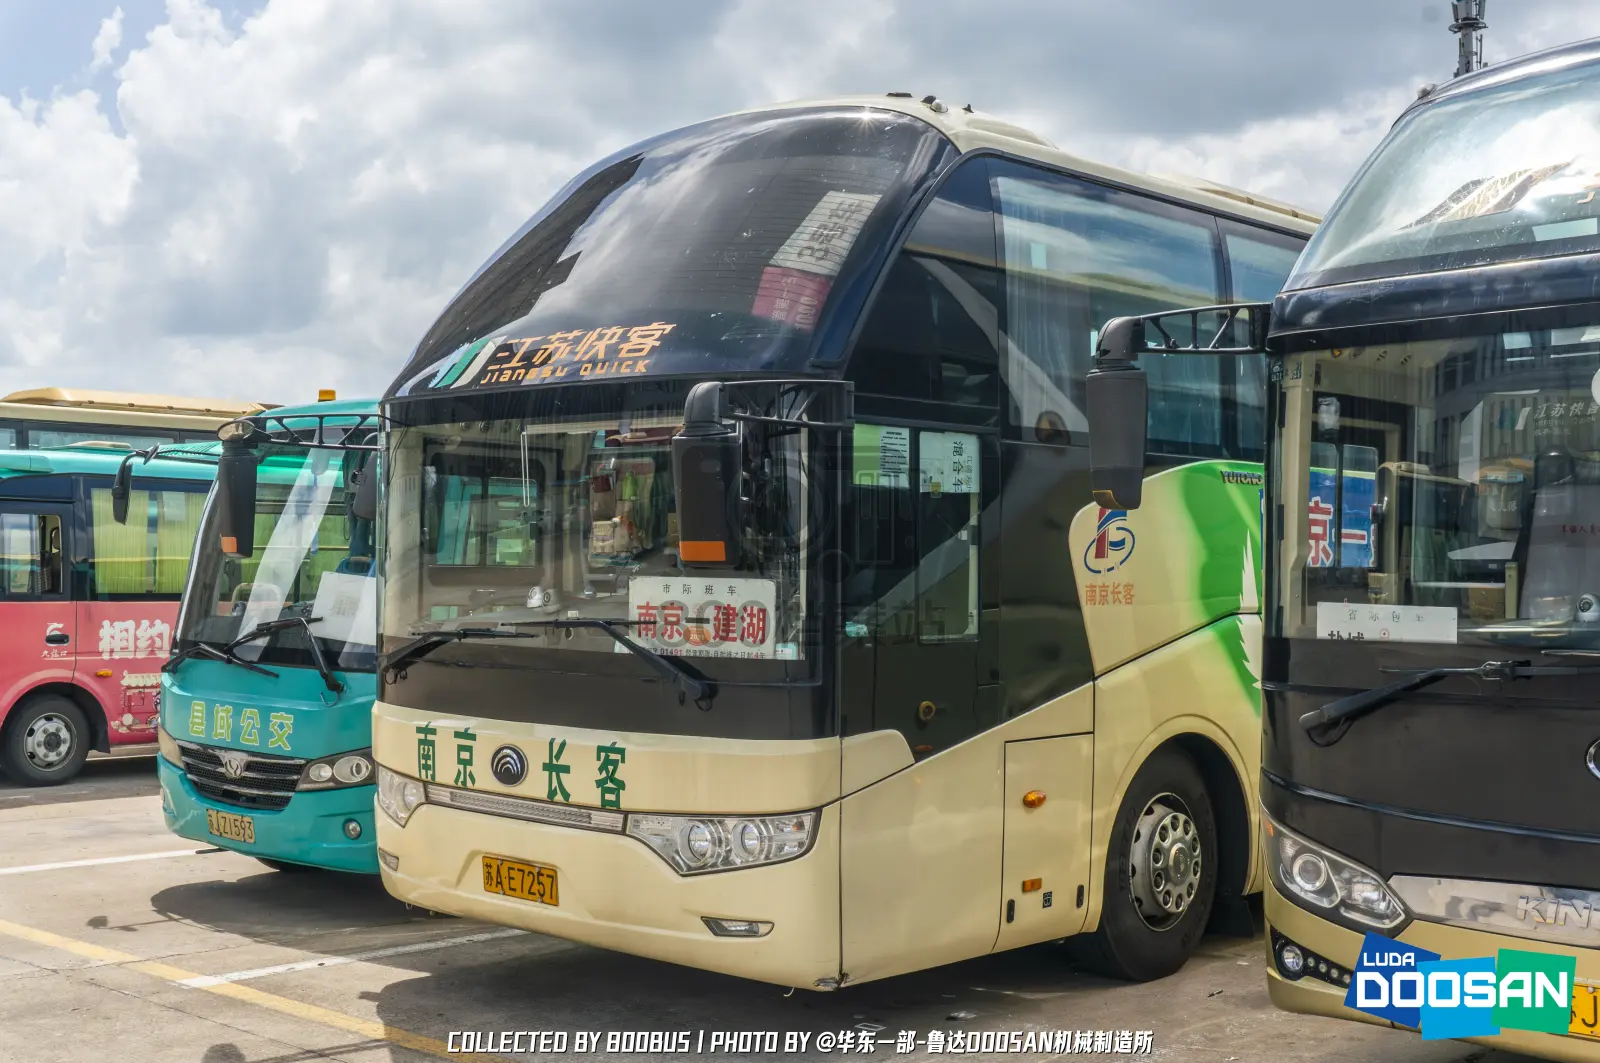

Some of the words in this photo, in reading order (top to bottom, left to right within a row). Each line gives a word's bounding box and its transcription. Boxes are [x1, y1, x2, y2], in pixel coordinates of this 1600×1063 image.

[487, 321, 677, 370] 江苏快客
[579, 360, 651, 376] QUICK
[1220, 471, 1264, 486] YUTONG
[662, 583, 737, 597] 市际班车
[1085, 582, 1135, 606] 南京长客
[99, 620, 170, 660] 相约
[189, 700, 294, 751] 县域公交
[1517, 895, 1600, 930] KIN
